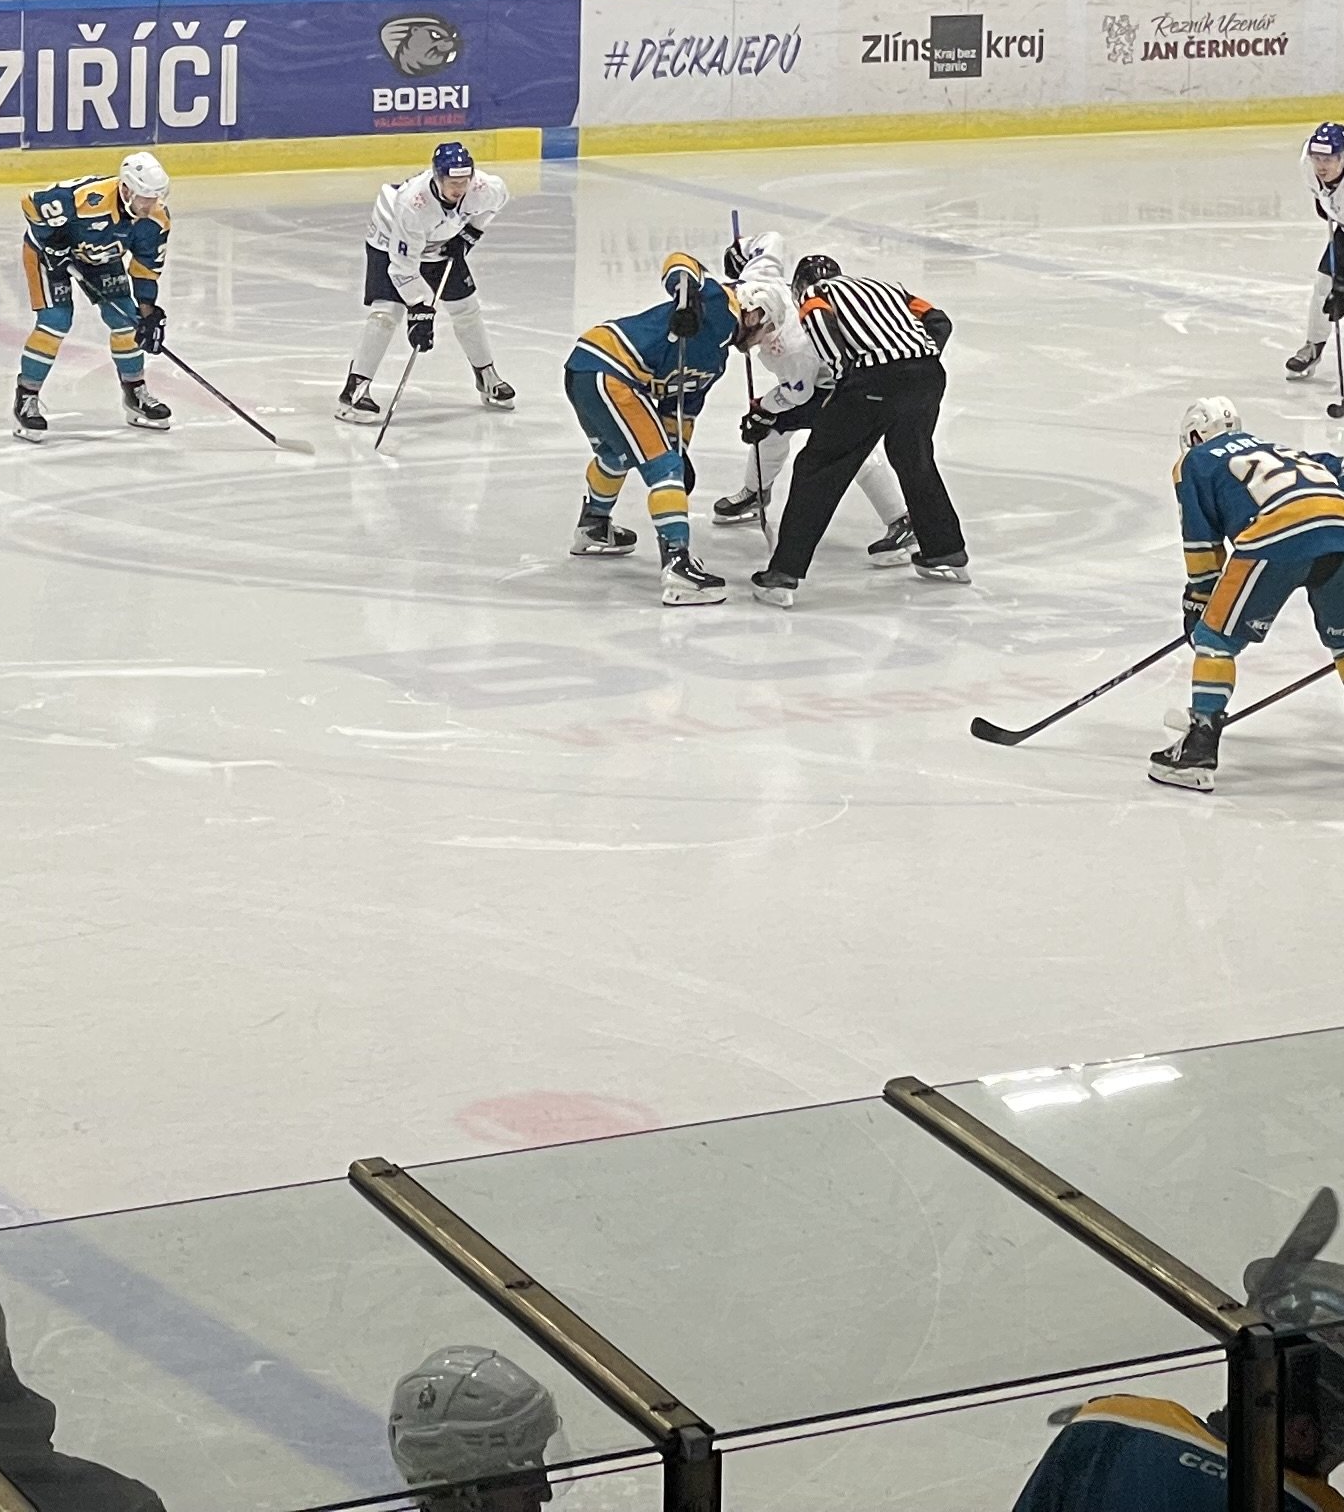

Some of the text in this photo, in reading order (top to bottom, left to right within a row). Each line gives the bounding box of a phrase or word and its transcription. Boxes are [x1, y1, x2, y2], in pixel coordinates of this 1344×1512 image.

[986, 29, 1045, 64] kraj
[1141, 32, 1289, 62] JAN ČERNOCKÝ
